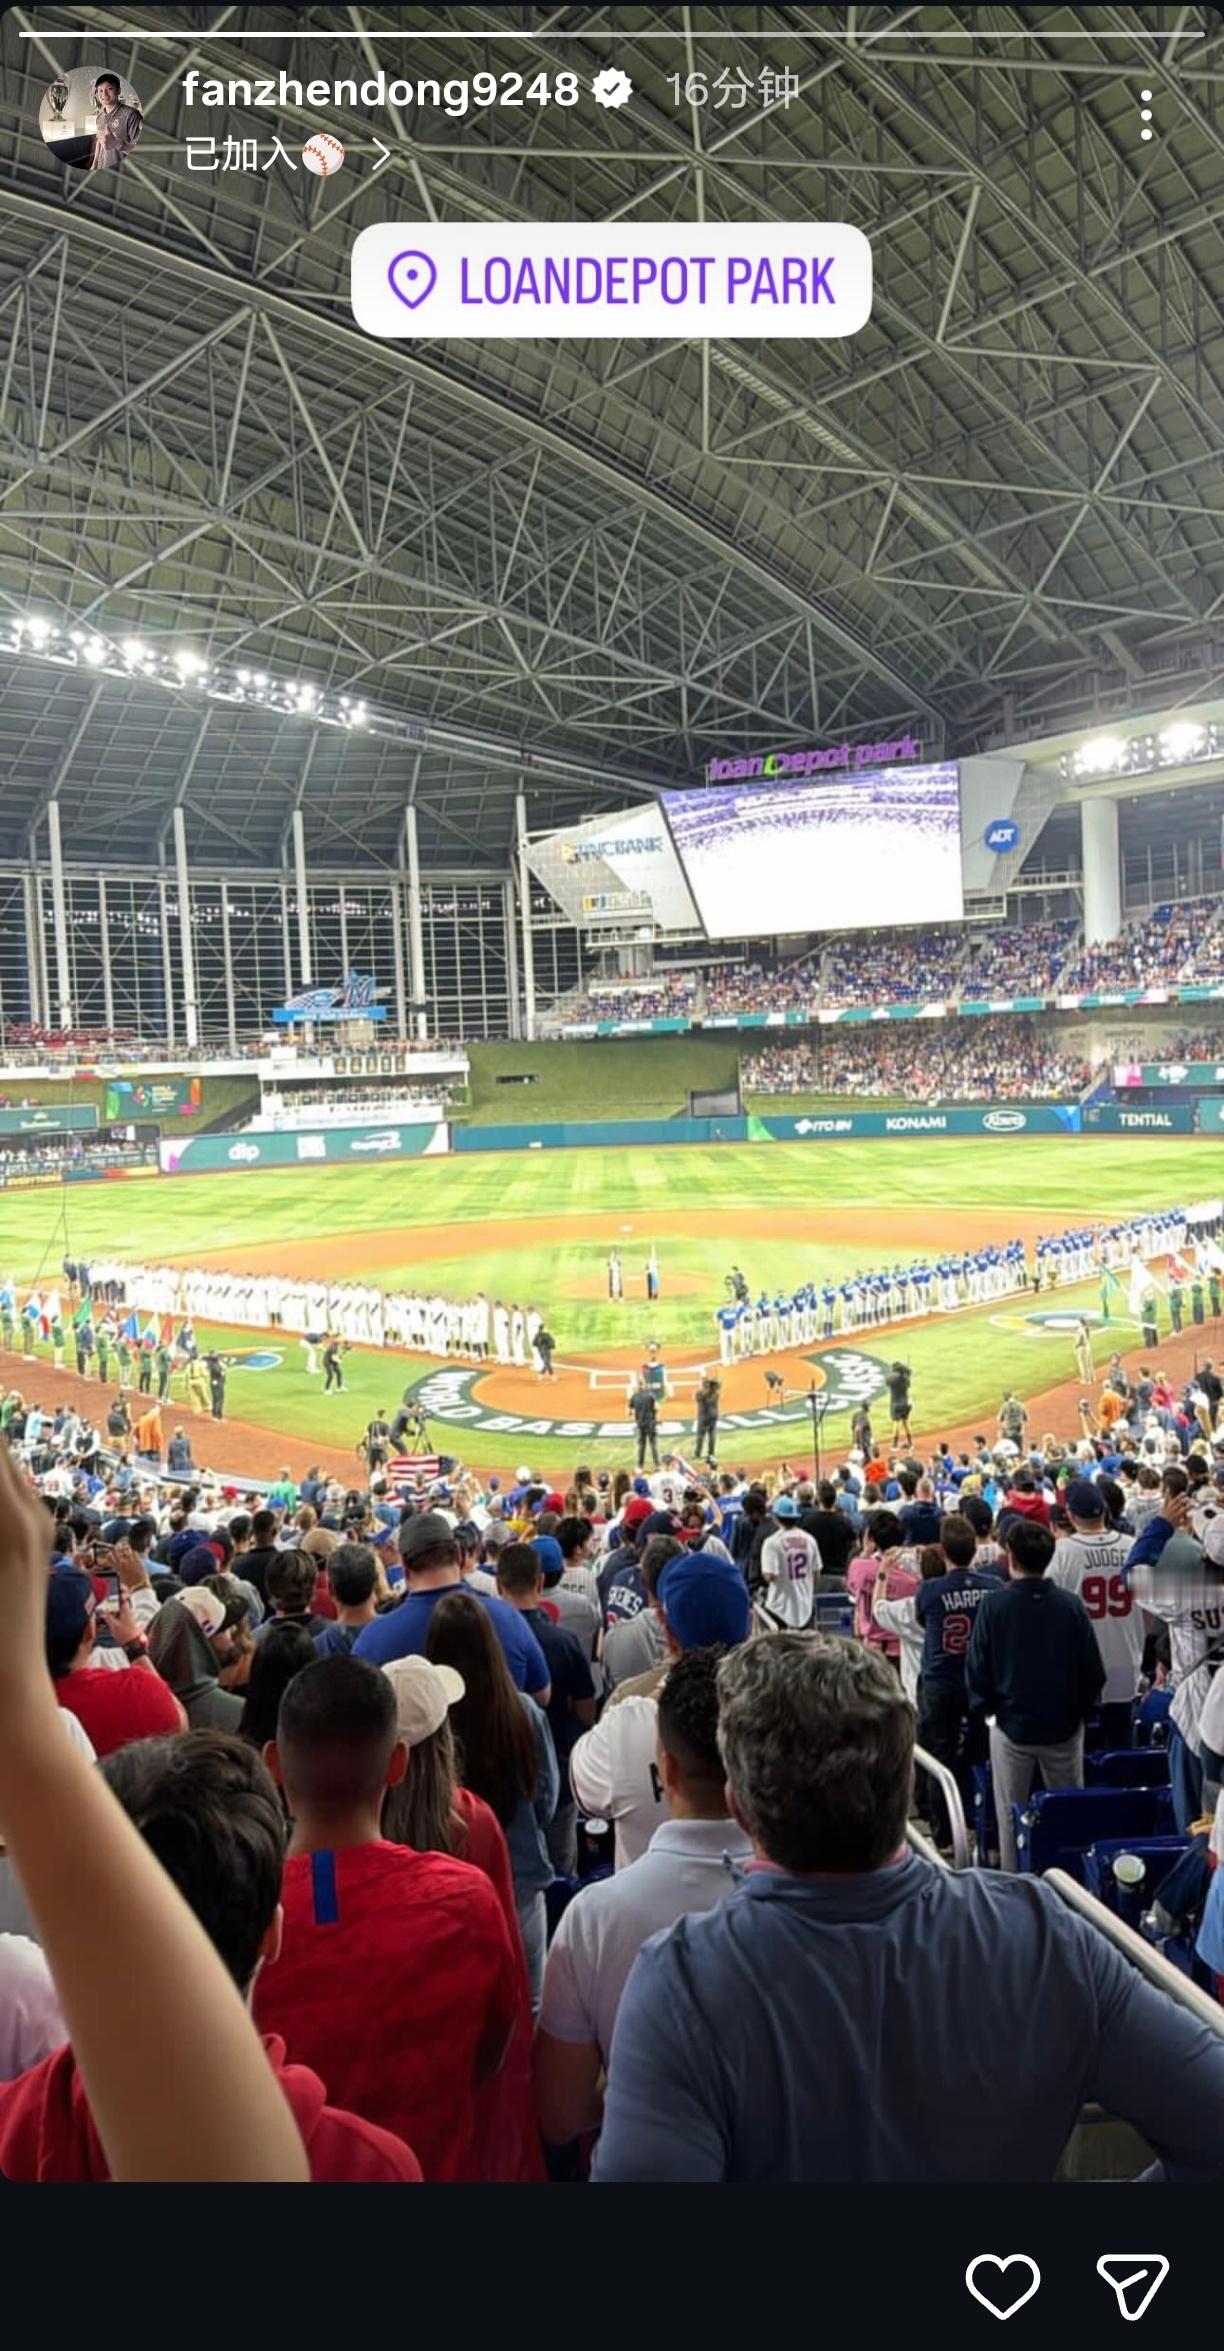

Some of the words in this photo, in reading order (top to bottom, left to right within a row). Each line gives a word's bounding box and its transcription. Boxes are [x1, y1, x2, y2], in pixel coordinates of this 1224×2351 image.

[854, 734, 919, 769] park
[989, 828, 1015, 843] ADT
[886, 1116, 947, 1130] KONAMI
[1119, 1113, 1173, 1127] TENTIAL
[787, 1553, 808, 1580] 12
[1081, 1574, 1133, 1619] 99
[1191, 1608, 1224, 1630] SU
[943, 1614, 972, 1654] 2
